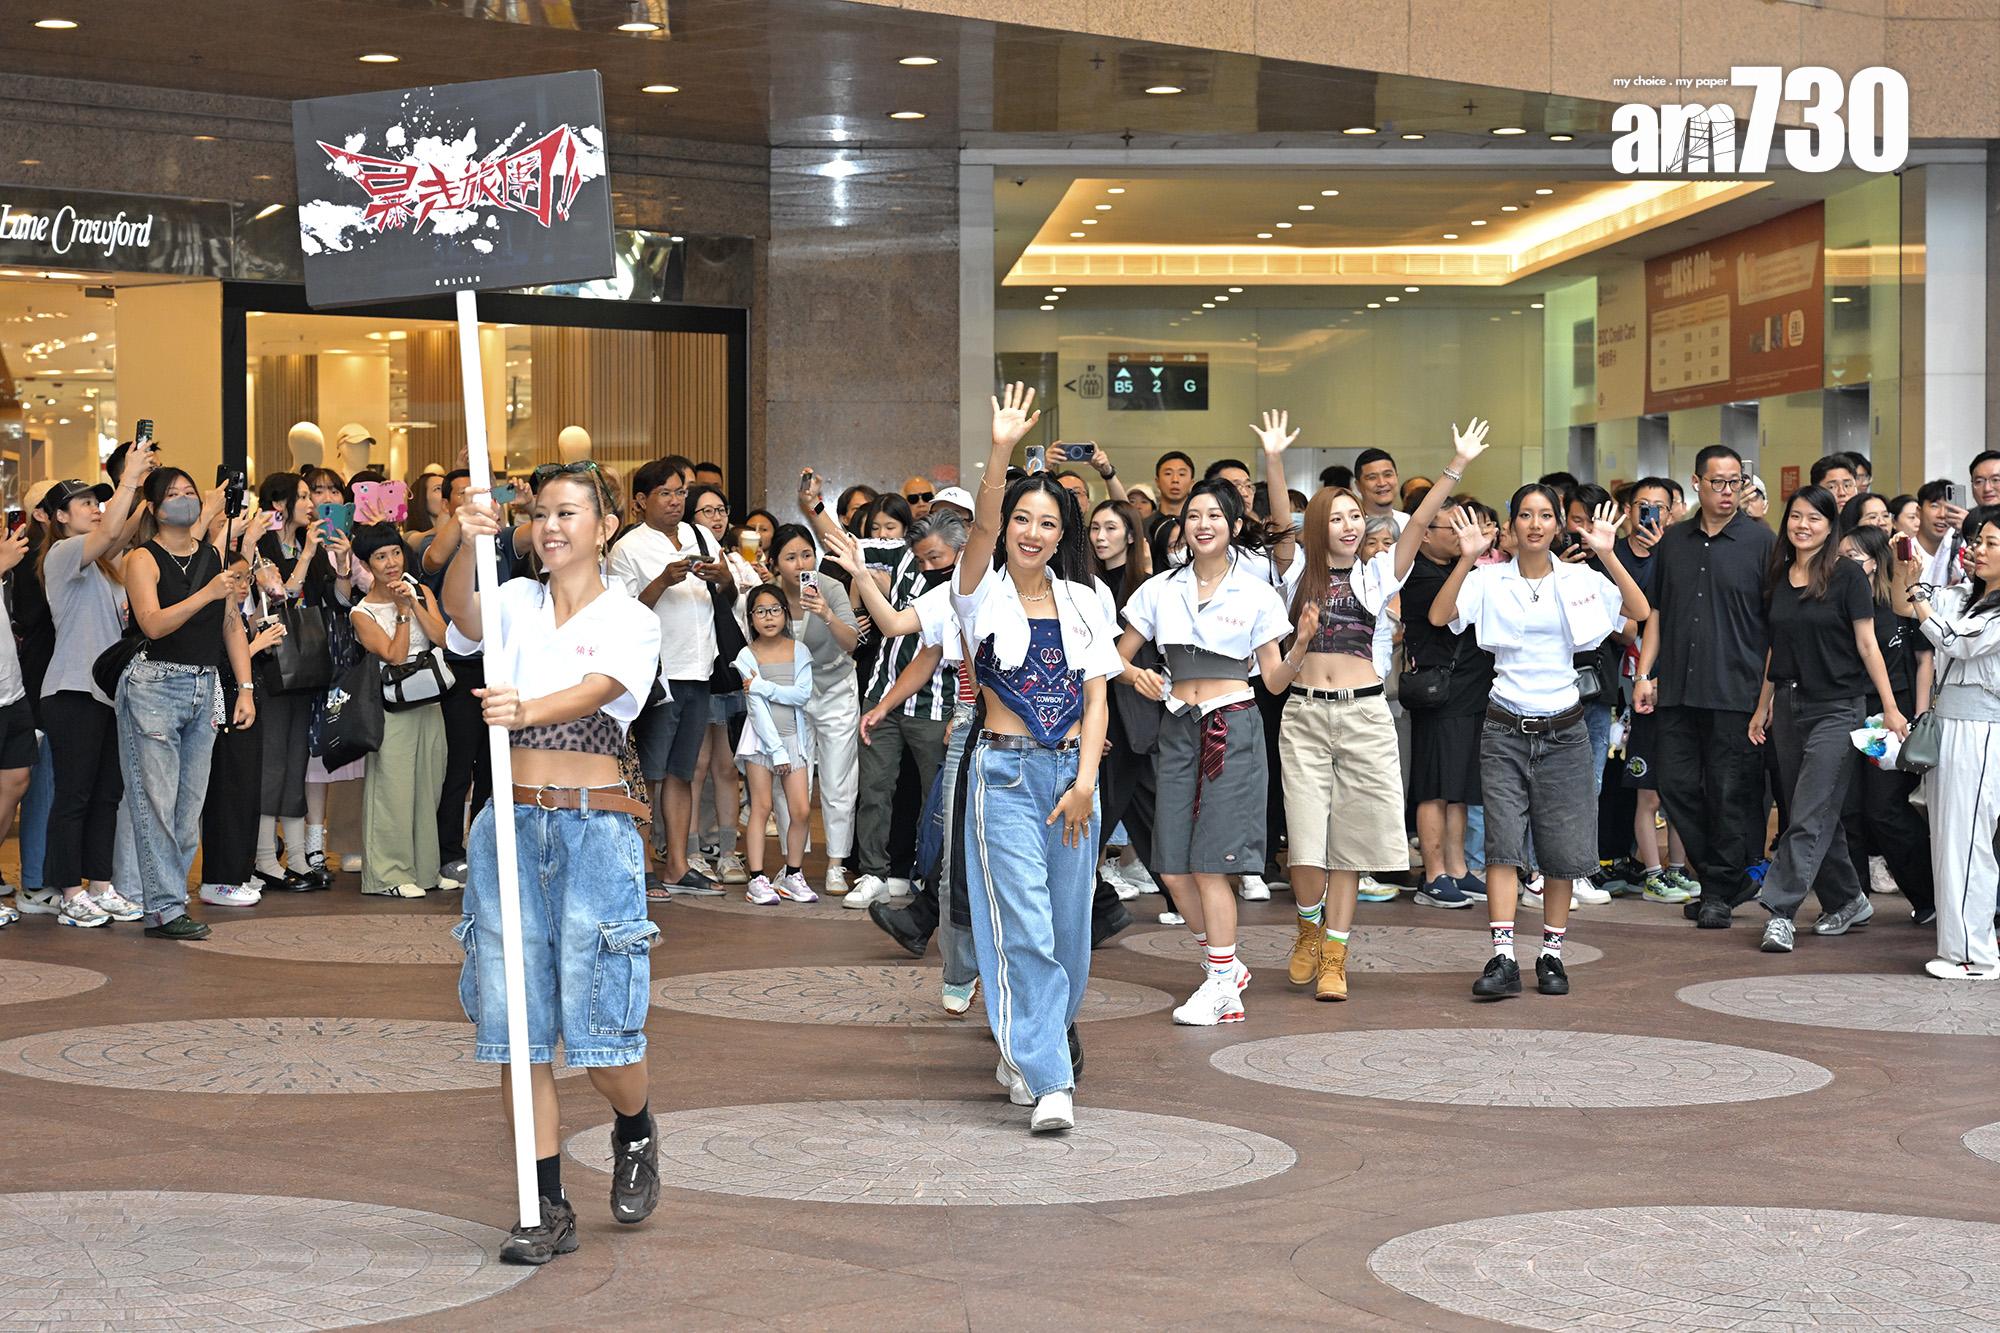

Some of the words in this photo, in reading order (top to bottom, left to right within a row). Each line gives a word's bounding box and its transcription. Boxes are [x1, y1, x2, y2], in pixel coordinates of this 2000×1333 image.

[0, 204, 49, 241] Lane
[52, 205, 153, 257] Crawford
[1114, 380, 1133, 394] B5
[1152, 380, 1162, 393] 2
[1183, 379, 1197, 393] G
[1036, 695, 1063, 704] COWBOY
